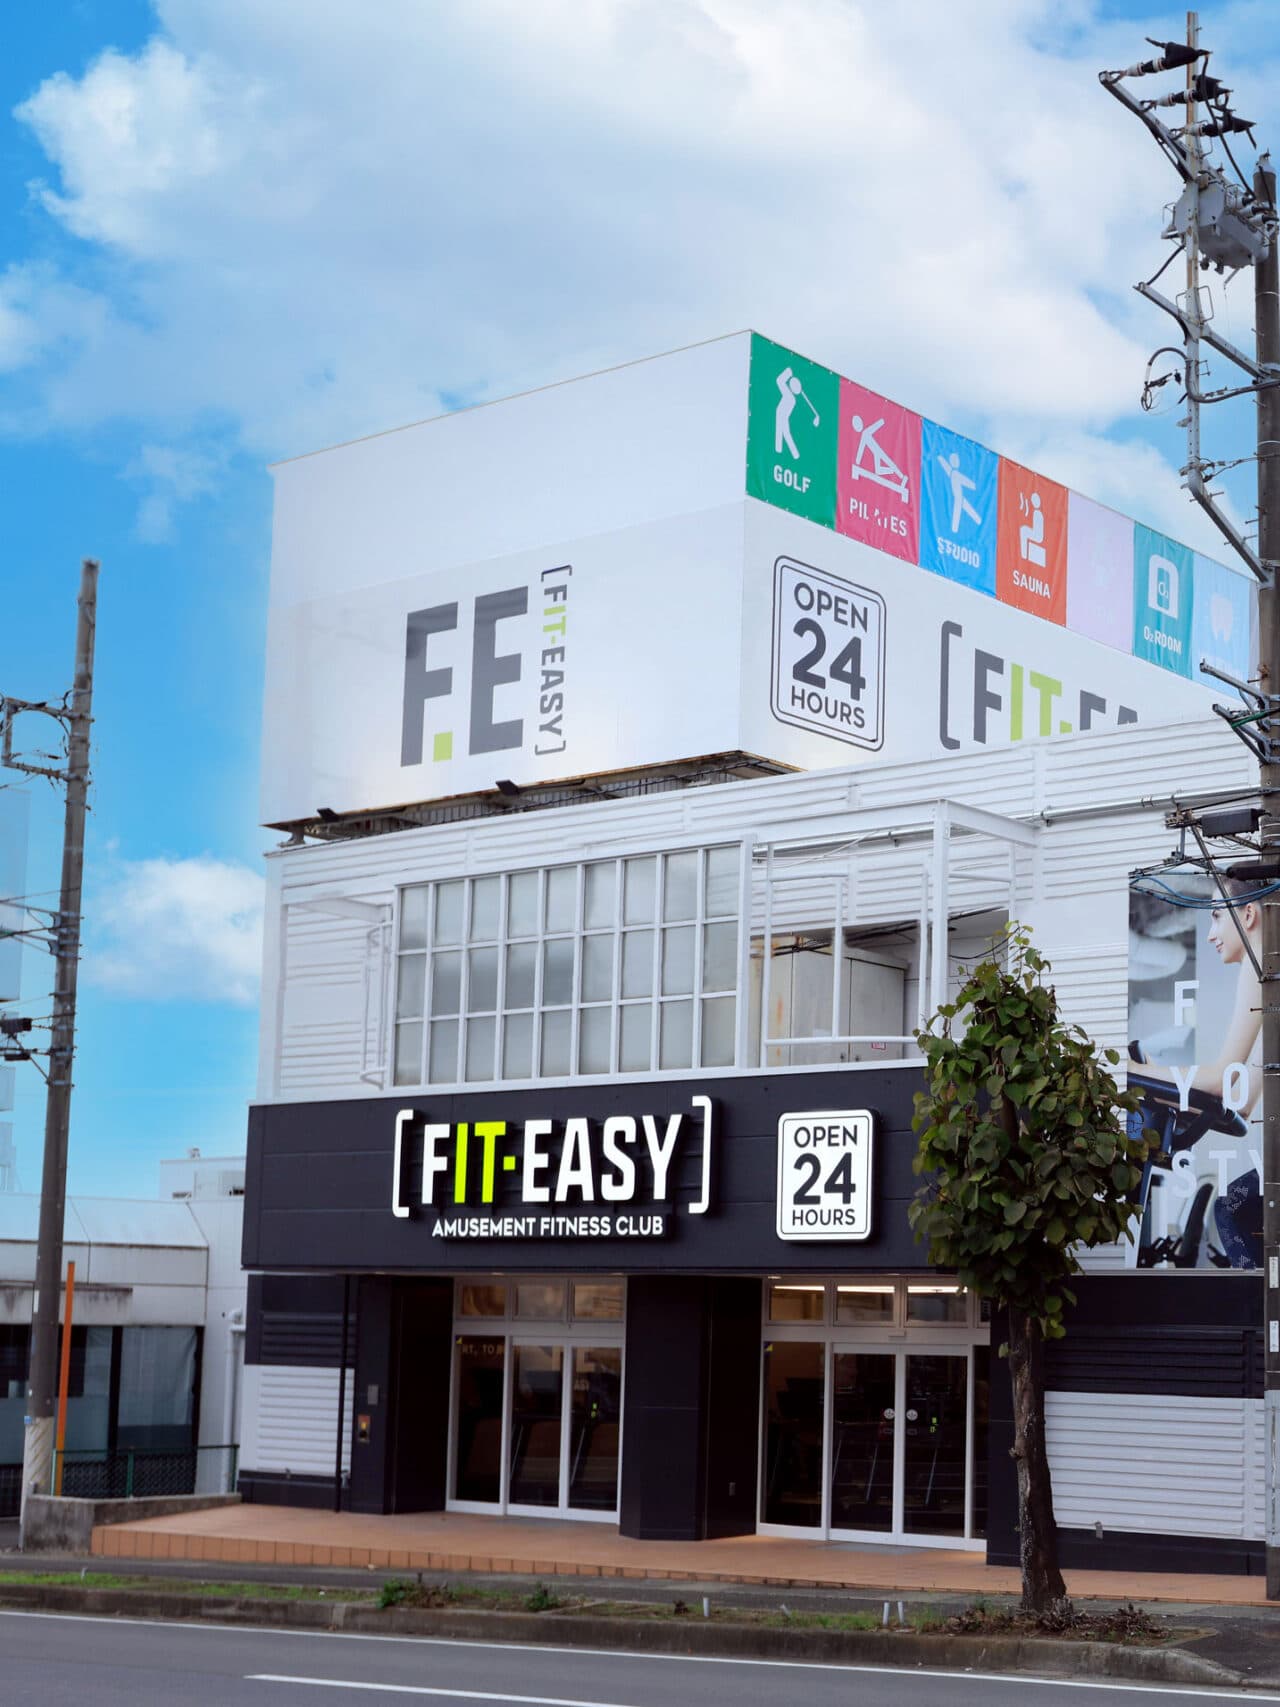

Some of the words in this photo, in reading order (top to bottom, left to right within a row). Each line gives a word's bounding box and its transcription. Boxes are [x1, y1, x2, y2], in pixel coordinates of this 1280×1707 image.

[773, 465, 811, 494] GOLF
[1012, 570, 1051, 599] SAUNA
[793, 582, 868, 634] OPEN
[792, 617, 866, 701] 24
[791, 684, 866, 730] HOURS
[793, 1124, 858, 1148] OPEN
[793, 1152, 856, 1205] 24
[431, 1217, 535, 1238] AMUSEMENT
[540, 1216, 611, 1237] FITNESS
[616, 1214, 664, 1237] CLUB
[792, 1208, 855, 1227] HOURS
